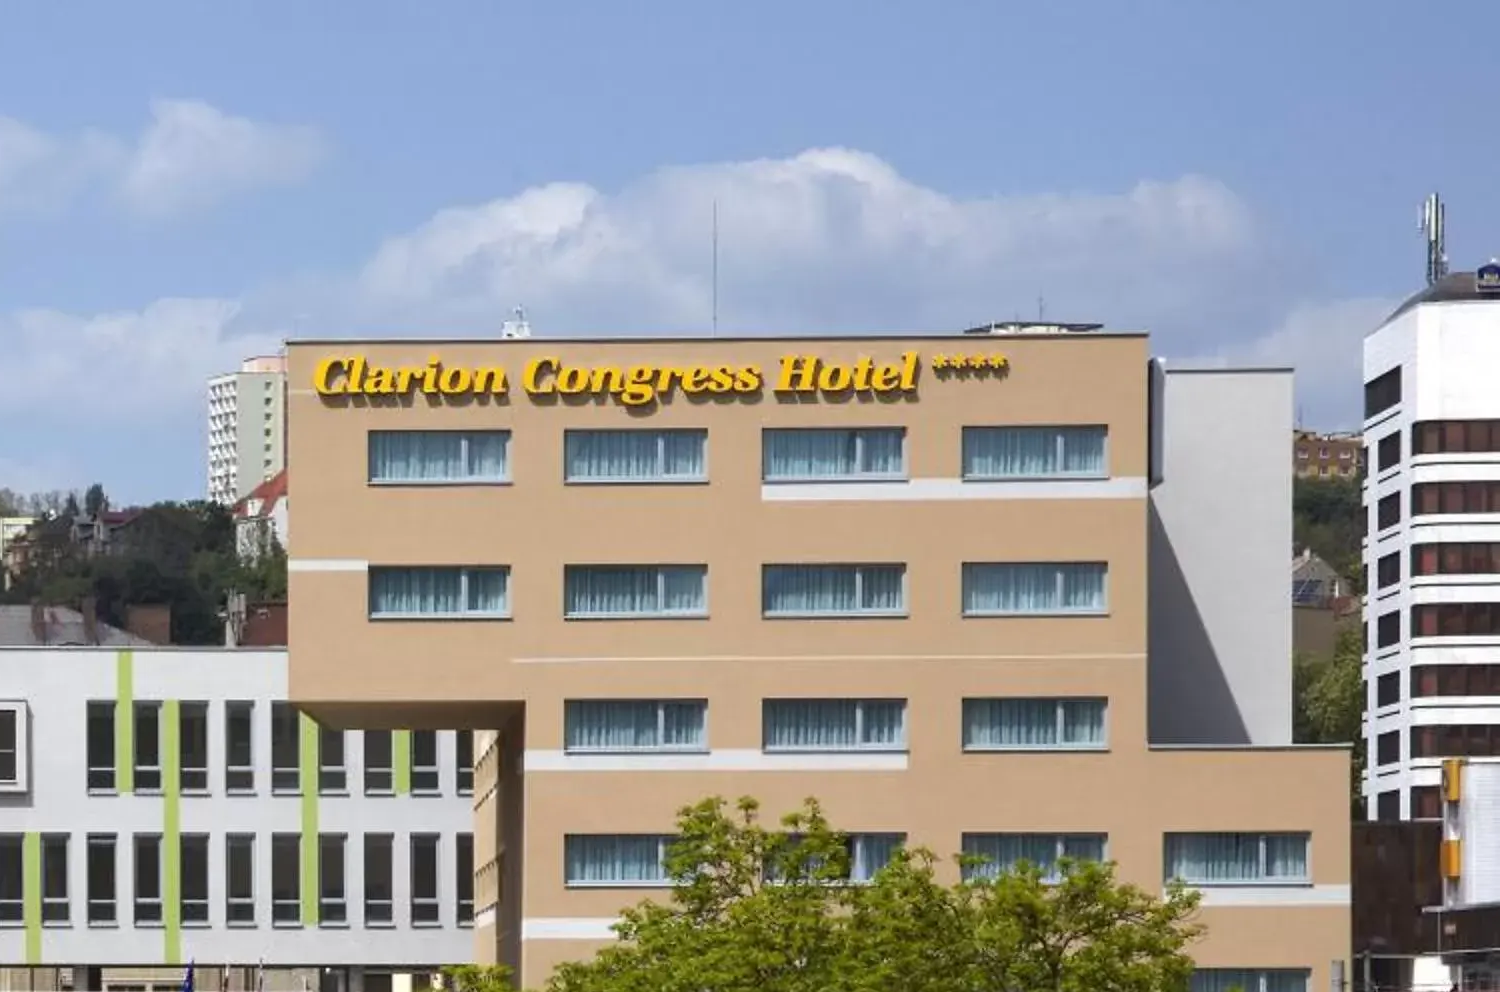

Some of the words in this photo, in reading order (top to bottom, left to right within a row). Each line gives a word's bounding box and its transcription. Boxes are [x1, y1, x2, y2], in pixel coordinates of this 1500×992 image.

[314, 353, 508, 395] Clarion
[523, 355, 763, 406] Congress
[773, 351, 919, 392] Hotel
